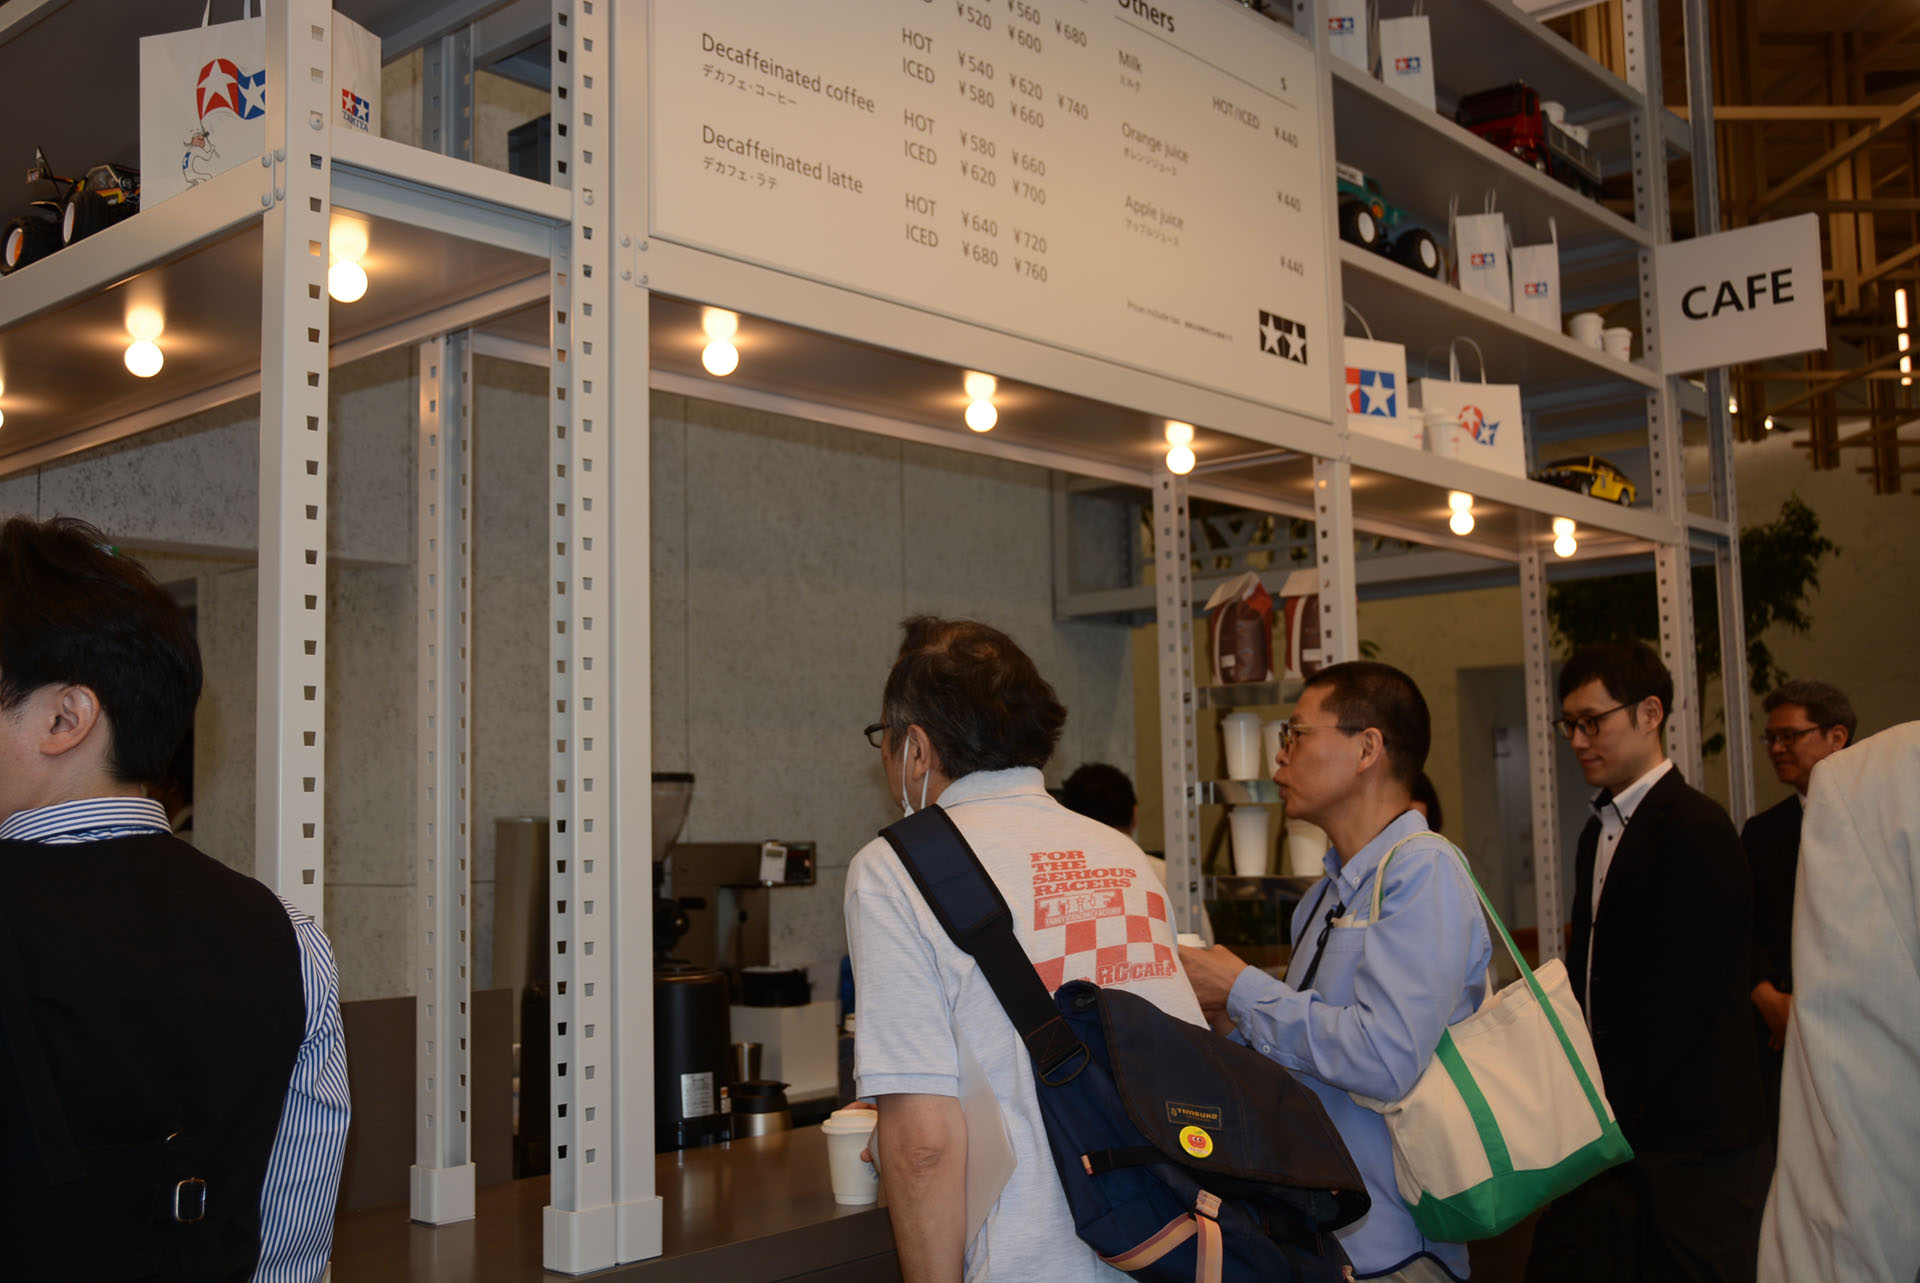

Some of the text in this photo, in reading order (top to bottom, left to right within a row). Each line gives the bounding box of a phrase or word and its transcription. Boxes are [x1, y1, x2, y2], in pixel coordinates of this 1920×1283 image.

[956, 0, 992, 31] ¥520
[1055, 19, 1087, 47] ¥680
[1008, 24, 1042, 53] ¥600
[702, 32, 875, 113] Decaffeinated coffee
[902, 27, 1089, 120] HOT ¥540 ¥620 ¥740
[1119, 50, 1142, 73] Milk
[903, 57, 1044, 129] ICED ¥580 ¥660
[702, 125, 863, 194] Decaffeinated latte
[904, 109, 1045, 177] HOT ¥580 ¥660
[1122, 121, 1189, 163] Orange juice
[904, 140, 1046, 206] ICED ¥620 ¥700
[905, 192, 1047, 254] HOT ¥640 ¥720
[1124, 194, 1184, 230] Apple juice
[906, 224, 1048, 283] ICED ¥680 ¥760
[1681, 267, 1794, 320] CAFE
[1029, 850, 1086, 862] FOR
[1032, 860, 1087, 872] THE
[1032, 868, 1137, 885] SERIOUS
[1033, 878, 1132, 897] RACERS
[1040, 890, 1115, 917] TRF
[1098, 961, 1130, 986] RC
